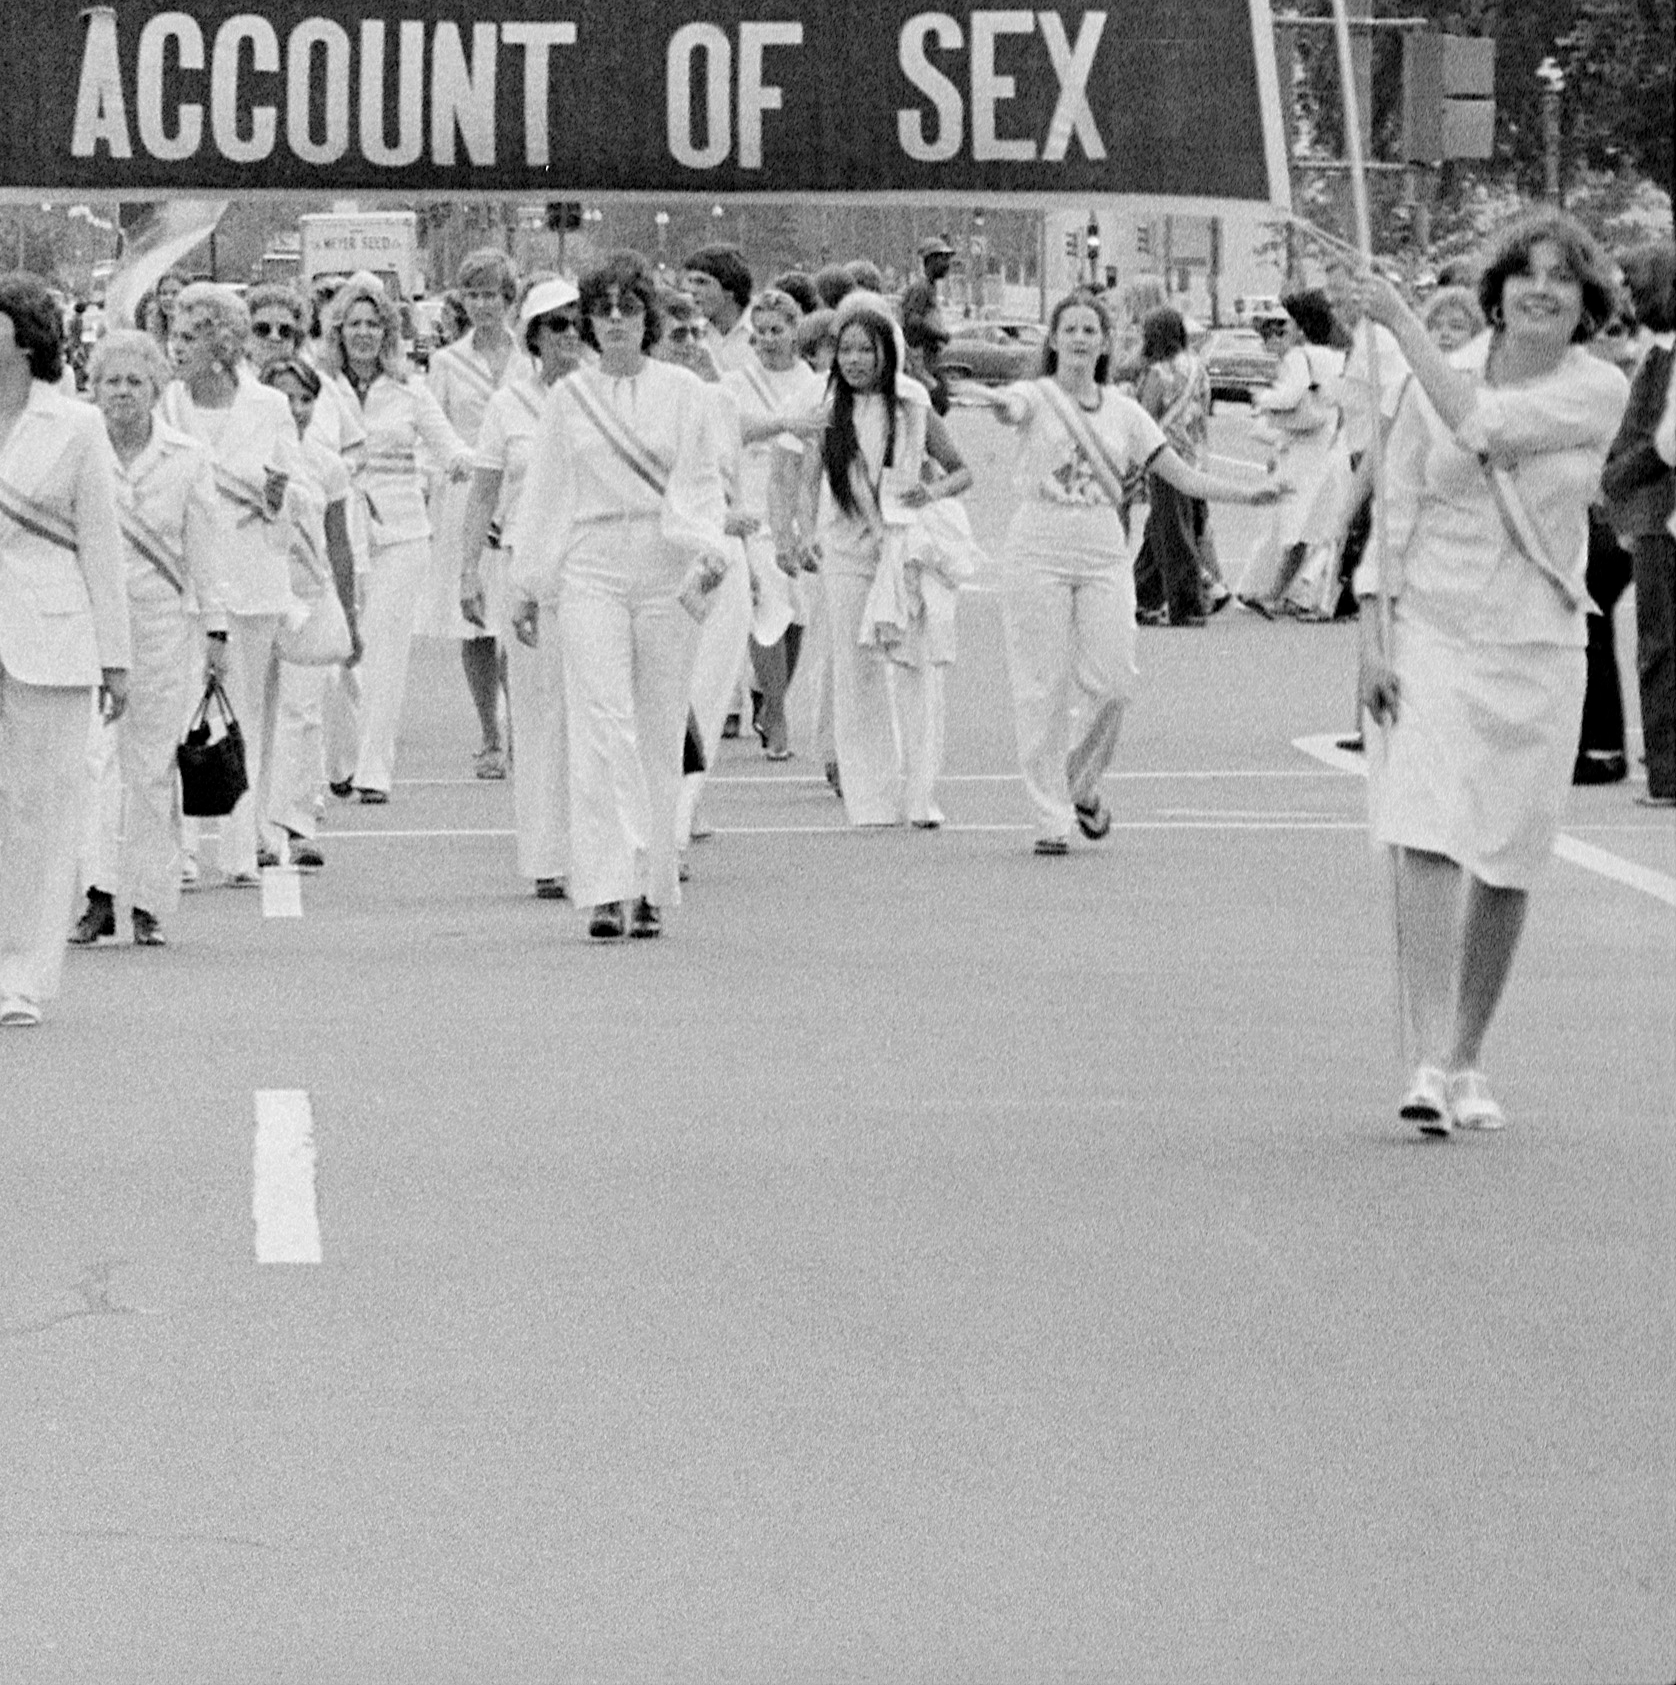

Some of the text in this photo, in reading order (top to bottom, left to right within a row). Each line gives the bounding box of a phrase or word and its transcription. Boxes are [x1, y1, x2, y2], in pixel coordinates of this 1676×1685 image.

[70, 5, 577, 167] ACCOUNT
[666, 21, 804, 169] OF
[897, 9, 1108, 162] SEX
